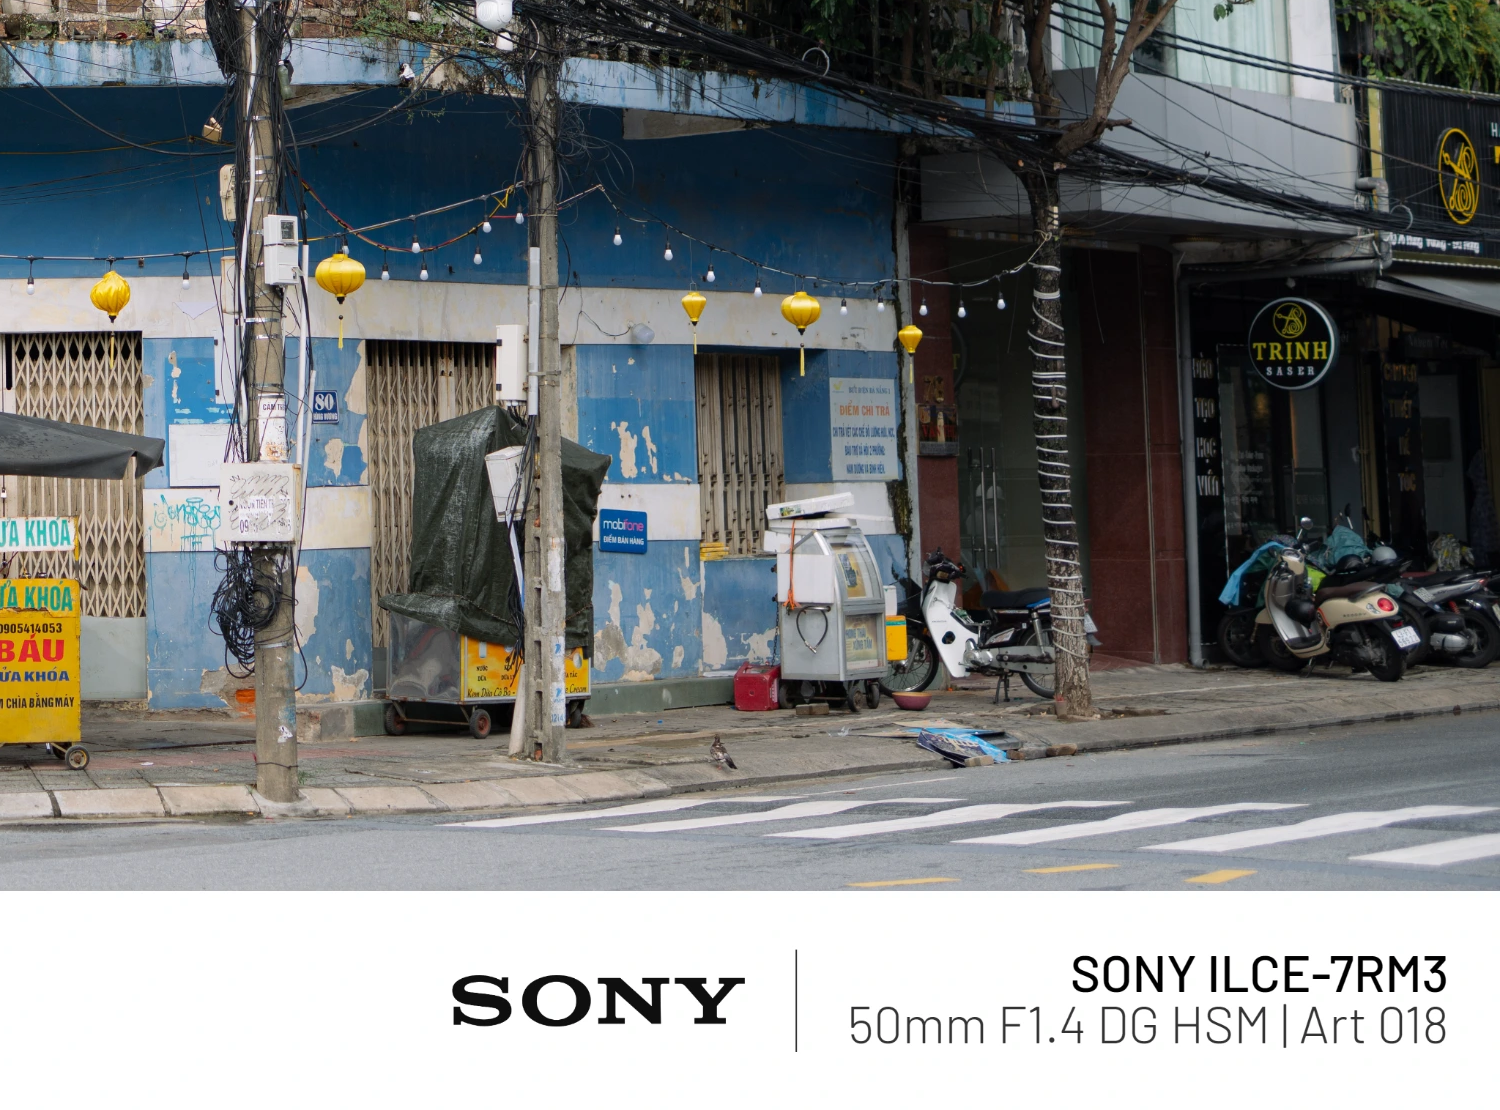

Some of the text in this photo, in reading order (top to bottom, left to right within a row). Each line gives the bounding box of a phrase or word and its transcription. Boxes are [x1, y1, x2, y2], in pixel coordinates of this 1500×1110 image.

[1252, 341, 1328, 364] TRỊNH
[1266, 366, 1315, 376] SASER
[315, 393, 334, 411] 80
[840, 400, 859, 416] ĐIỂM
[876, 402, 890, 416] TRẢ
[25, 516, 71, 547] KHÓA
[603, 518, 644, 532] mobifone
[25, 580, 73, 611] KHÓA
[24, 666, 70, 682] KHÓA
[6, 695, 27, 708] CHÌA
[29, 692, 54, 708] BẰNG
[56, 694, 74, 707] MÁY
